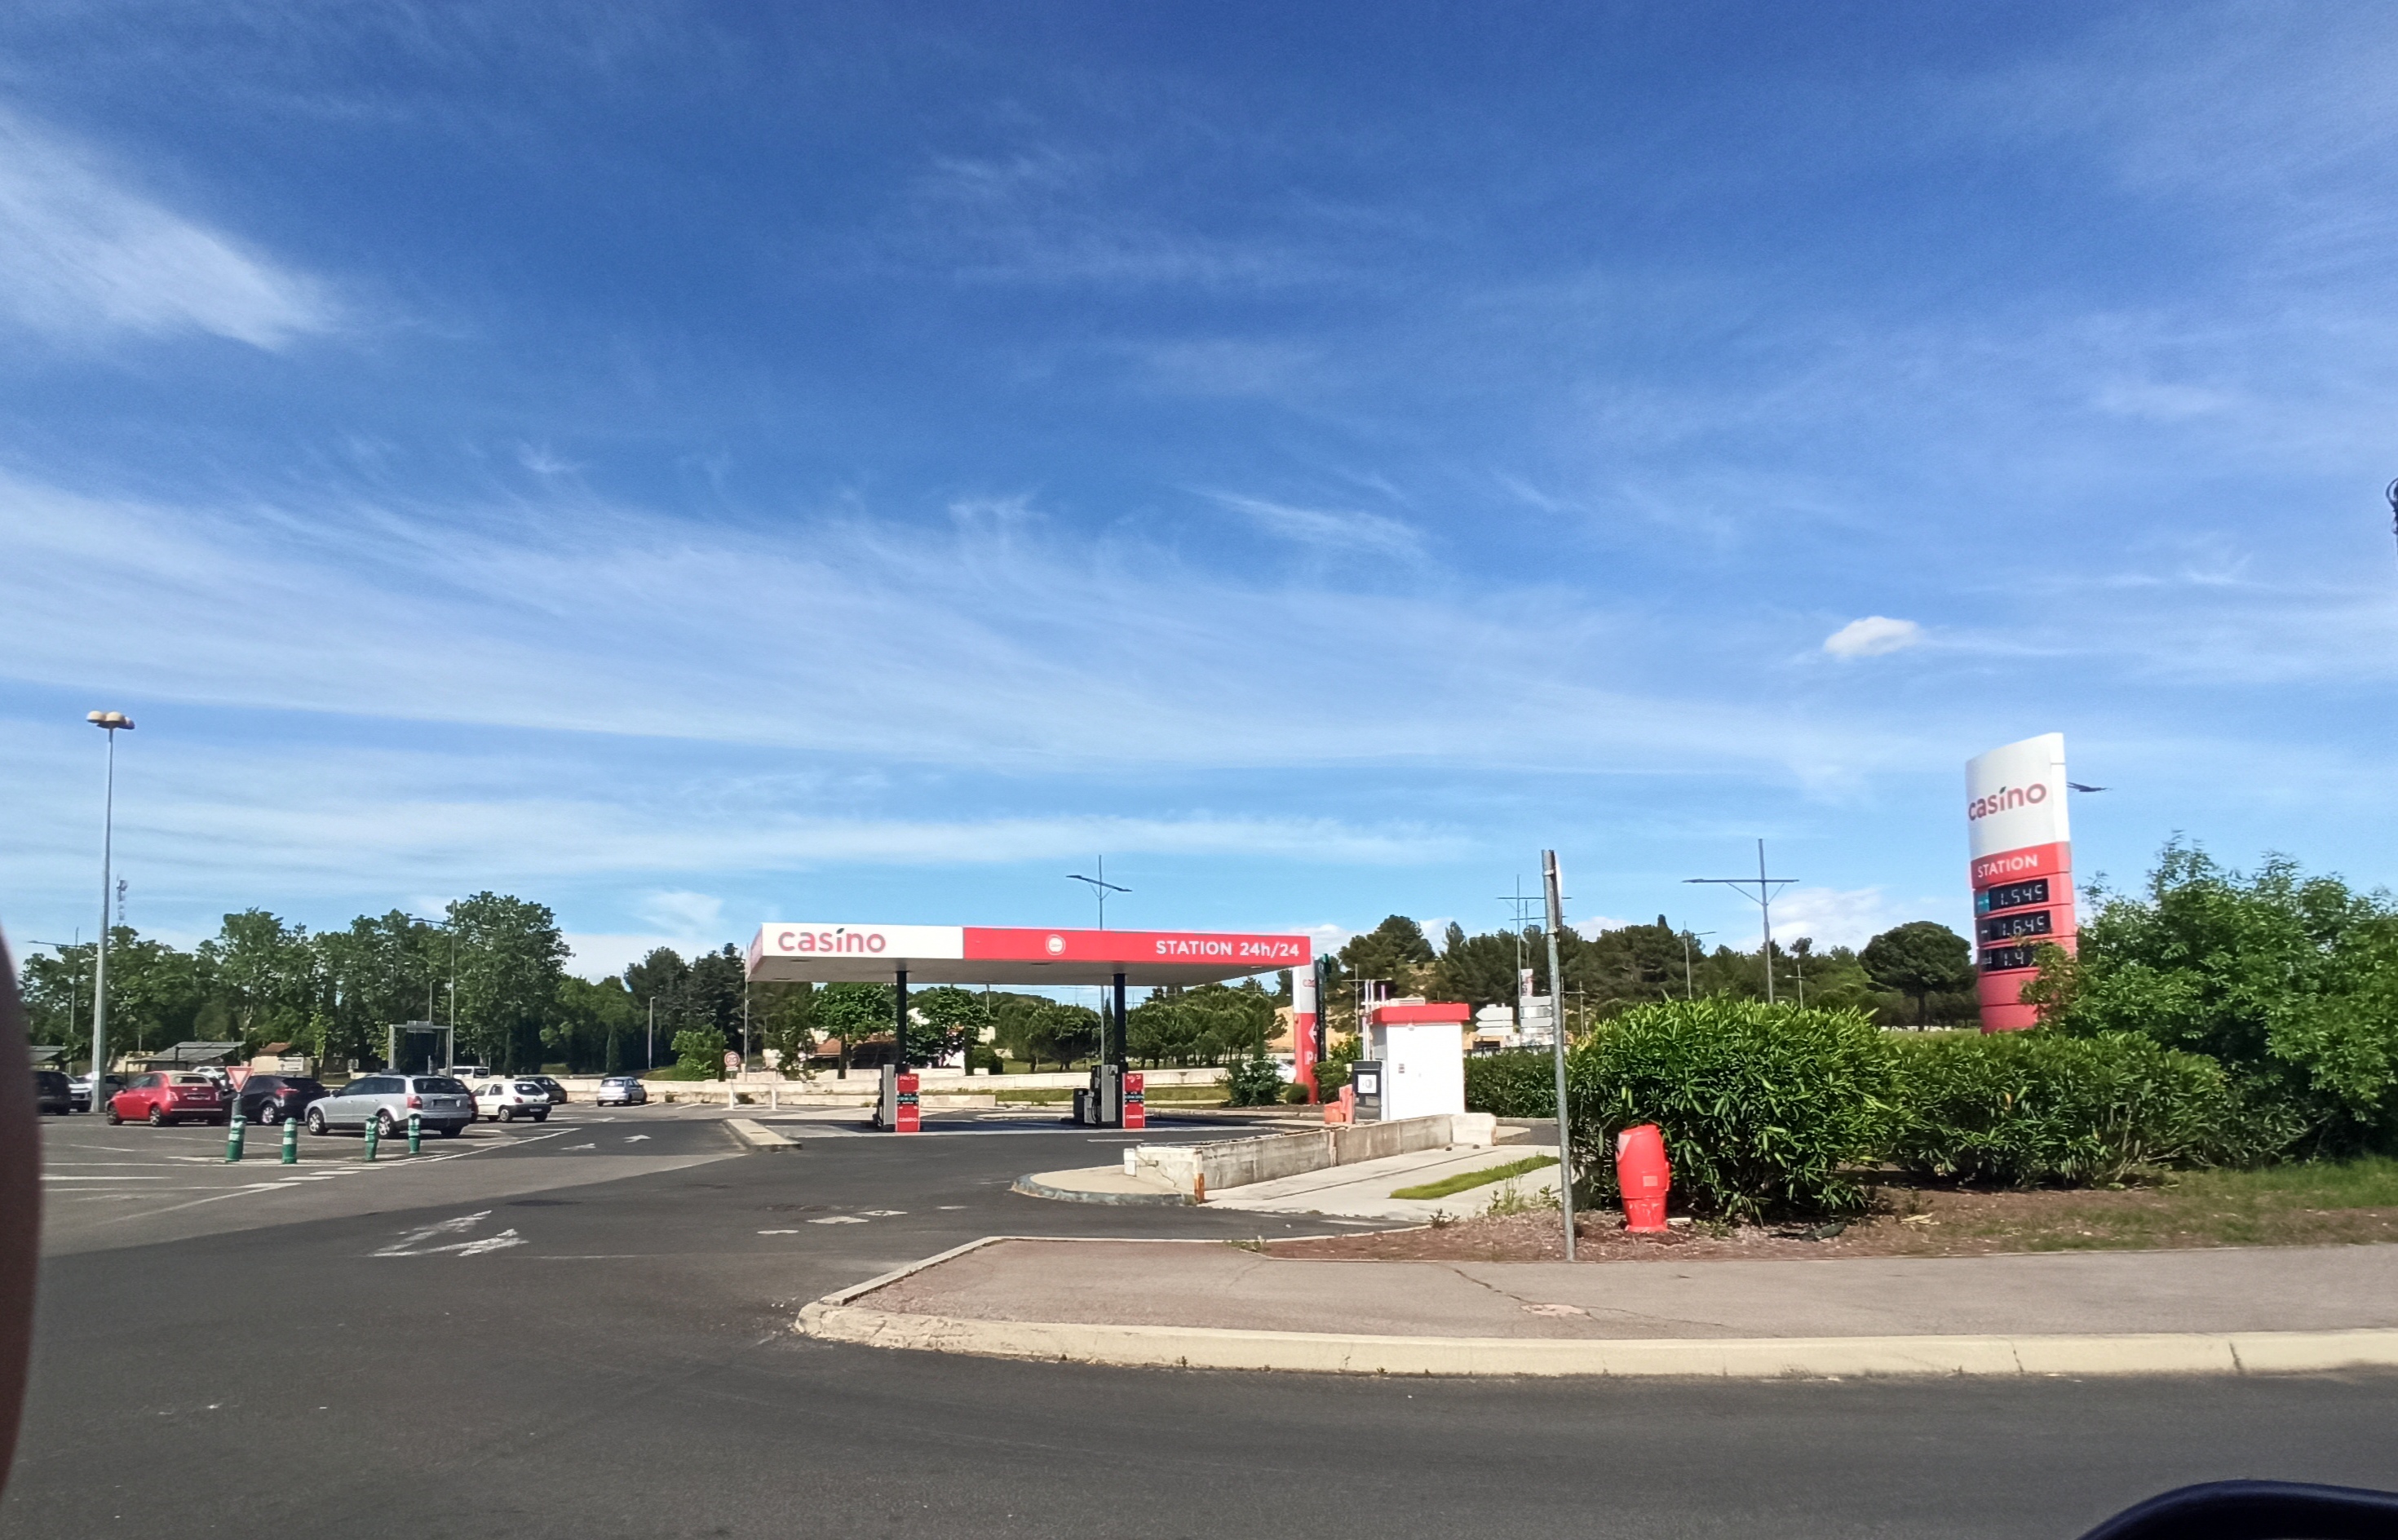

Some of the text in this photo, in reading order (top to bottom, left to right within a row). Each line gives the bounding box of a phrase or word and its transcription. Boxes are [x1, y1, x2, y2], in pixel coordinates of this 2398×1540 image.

[1968, 783, 2047, 821] casino
[1977, 854, 2038, 878] STATION
[777, 927, 887, 954] casino
[1156, 940, 1299, 958] STATION 24h/24
